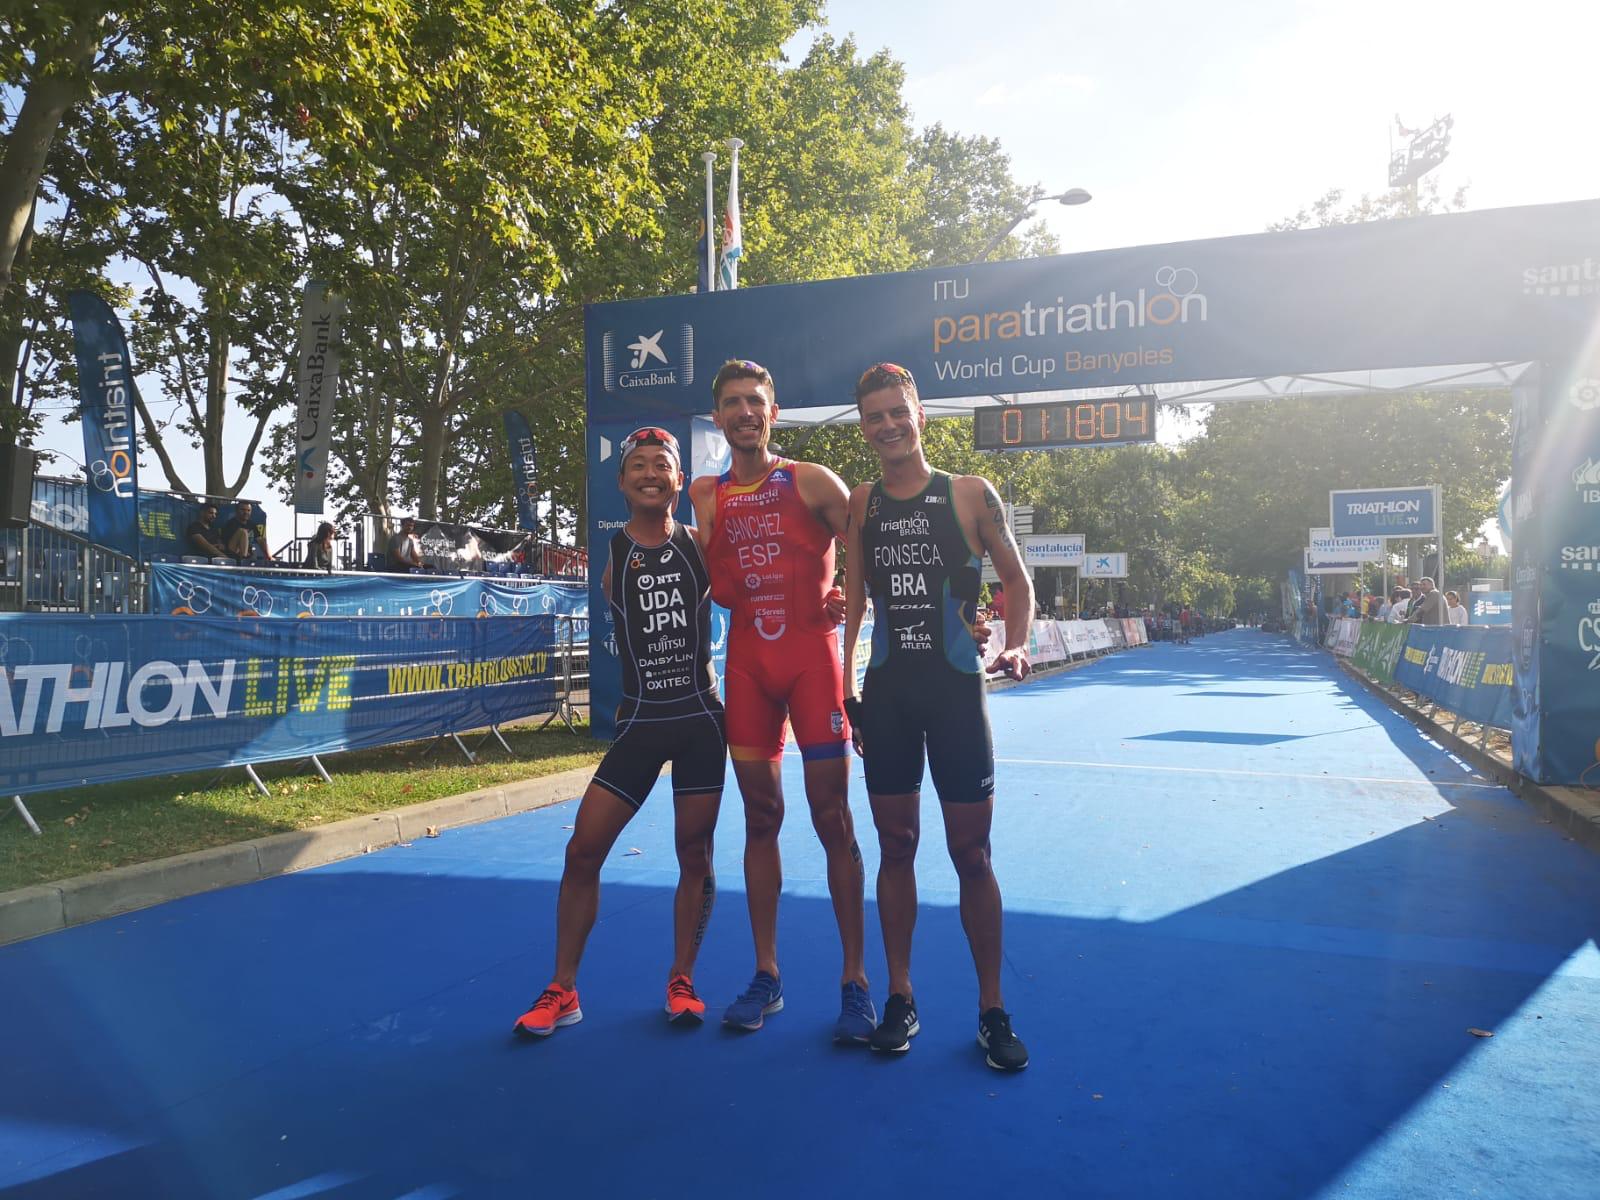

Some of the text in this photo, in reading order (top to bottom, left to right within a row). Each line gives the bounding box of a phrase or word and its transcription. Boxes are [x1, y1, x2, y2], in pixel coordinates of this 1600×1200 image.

[1522, 257, 1600, 285] sant
[933, 278, 970, 301] ITU
[933, 287, 1208, 353] paratriathlon
[934, 345, 1174, 381] World Cup Banyoles
[300, 312, 331, 442] CaixaBank
[619, 371, 677, 389] CaixaBank
[98, 352, 134, 499] triathlon
[1002, 401, 1147, 445] 01:18:04
[1346, 499, 1420, 516] TRIATHLON
[725, 512, 785, 544] SANCHEZ
[880, 517, 930, 532] triathlon
[899, 527, 930, 536] BRASIL
[738, 542, 781, 569] ESP
[874, 543, 944, 568] FONSECA
[656, 572, 681, 585] NTT
[891, 572, 928, 597] BRA
[639, 588, 684, 612] UDA
[643, 609, 688, 634] JPN
[648, 634, 686, 654] FUJITSU
[900, 633, 931, 641] BOLSA
[901, 642, 932, 650] ATLETA
[245, 655, 357, 717] LIVE
[647, 675, 691, 690] OXITEC
